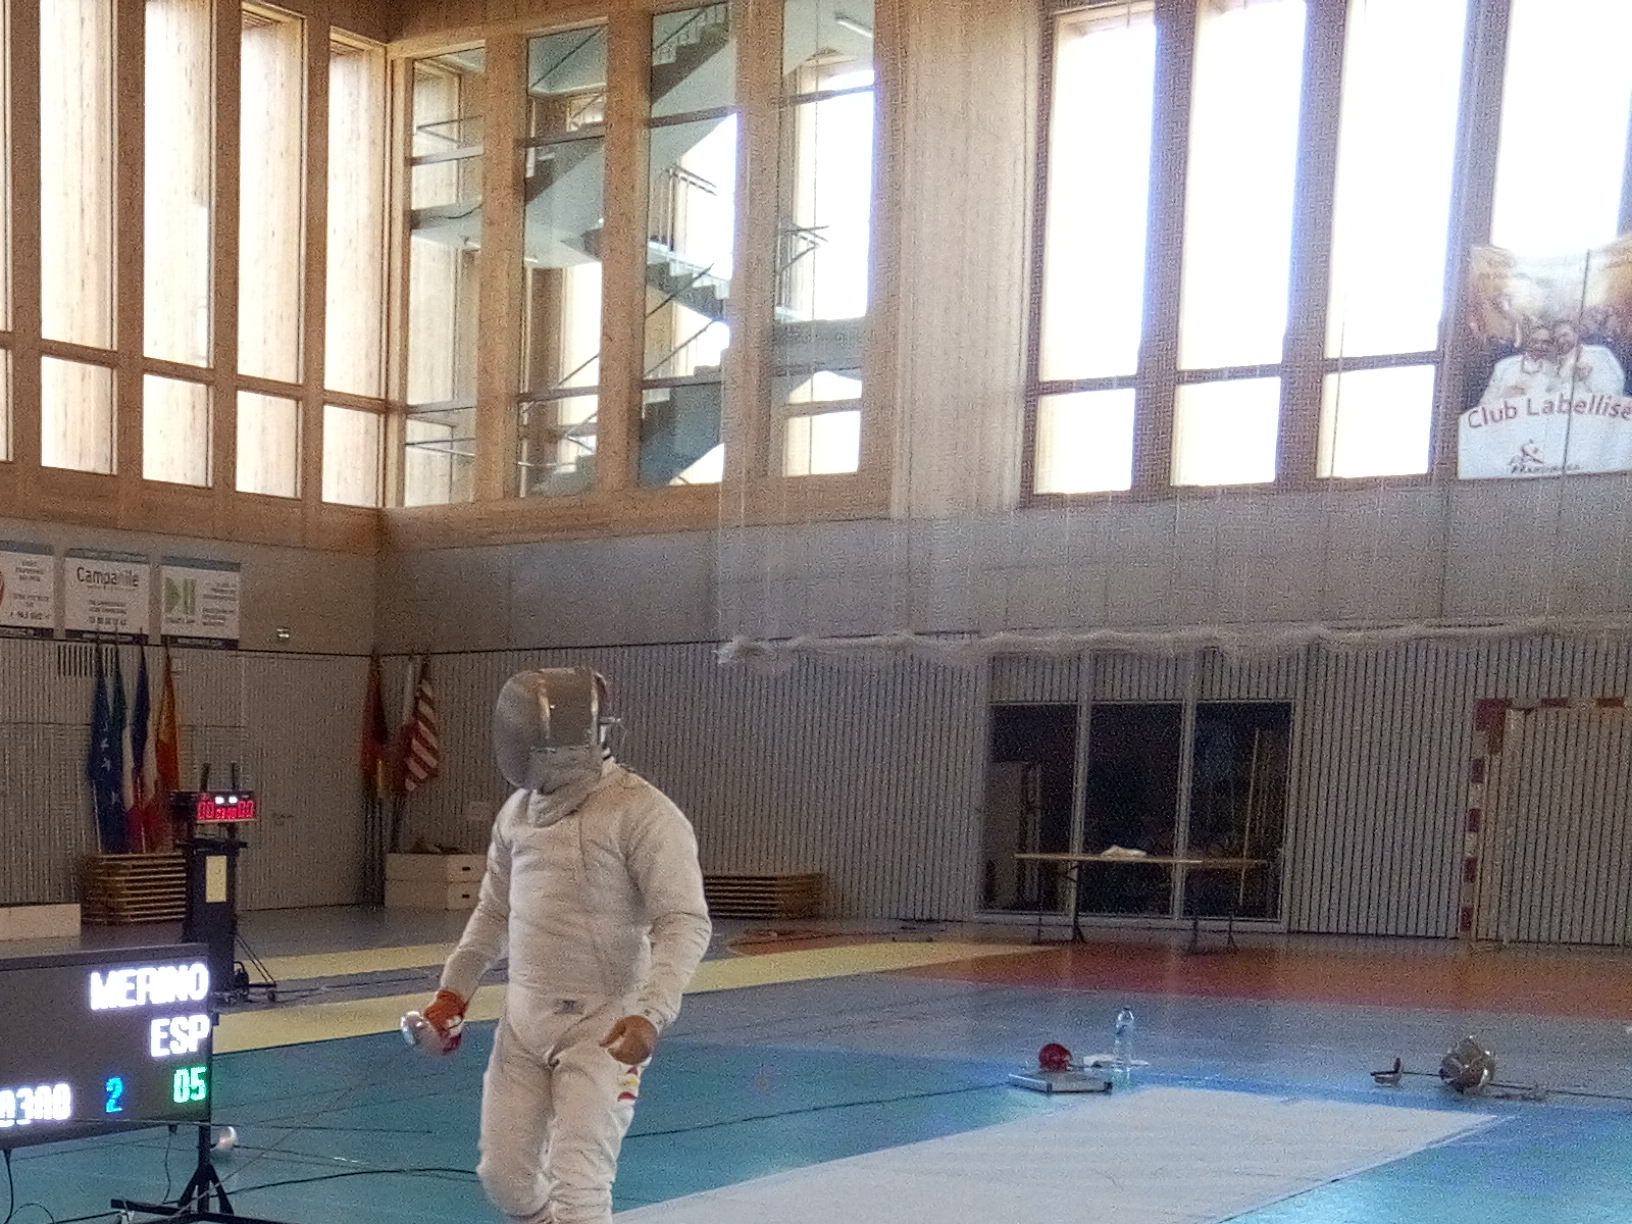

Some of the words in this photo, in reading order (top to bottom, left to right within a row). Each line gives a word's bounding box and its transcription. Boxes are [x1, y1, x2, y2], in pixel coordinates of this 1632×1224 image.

[1468, 402, 1518, 429] Club
[76, 566, 139, 587] Campanile
[89, 962, 210, 1011] MERINO
[150, 1014, 211, 1058] ESP
[105, 1076, 125, 1113] 2
[173, 1066, 207, 1103] 05
